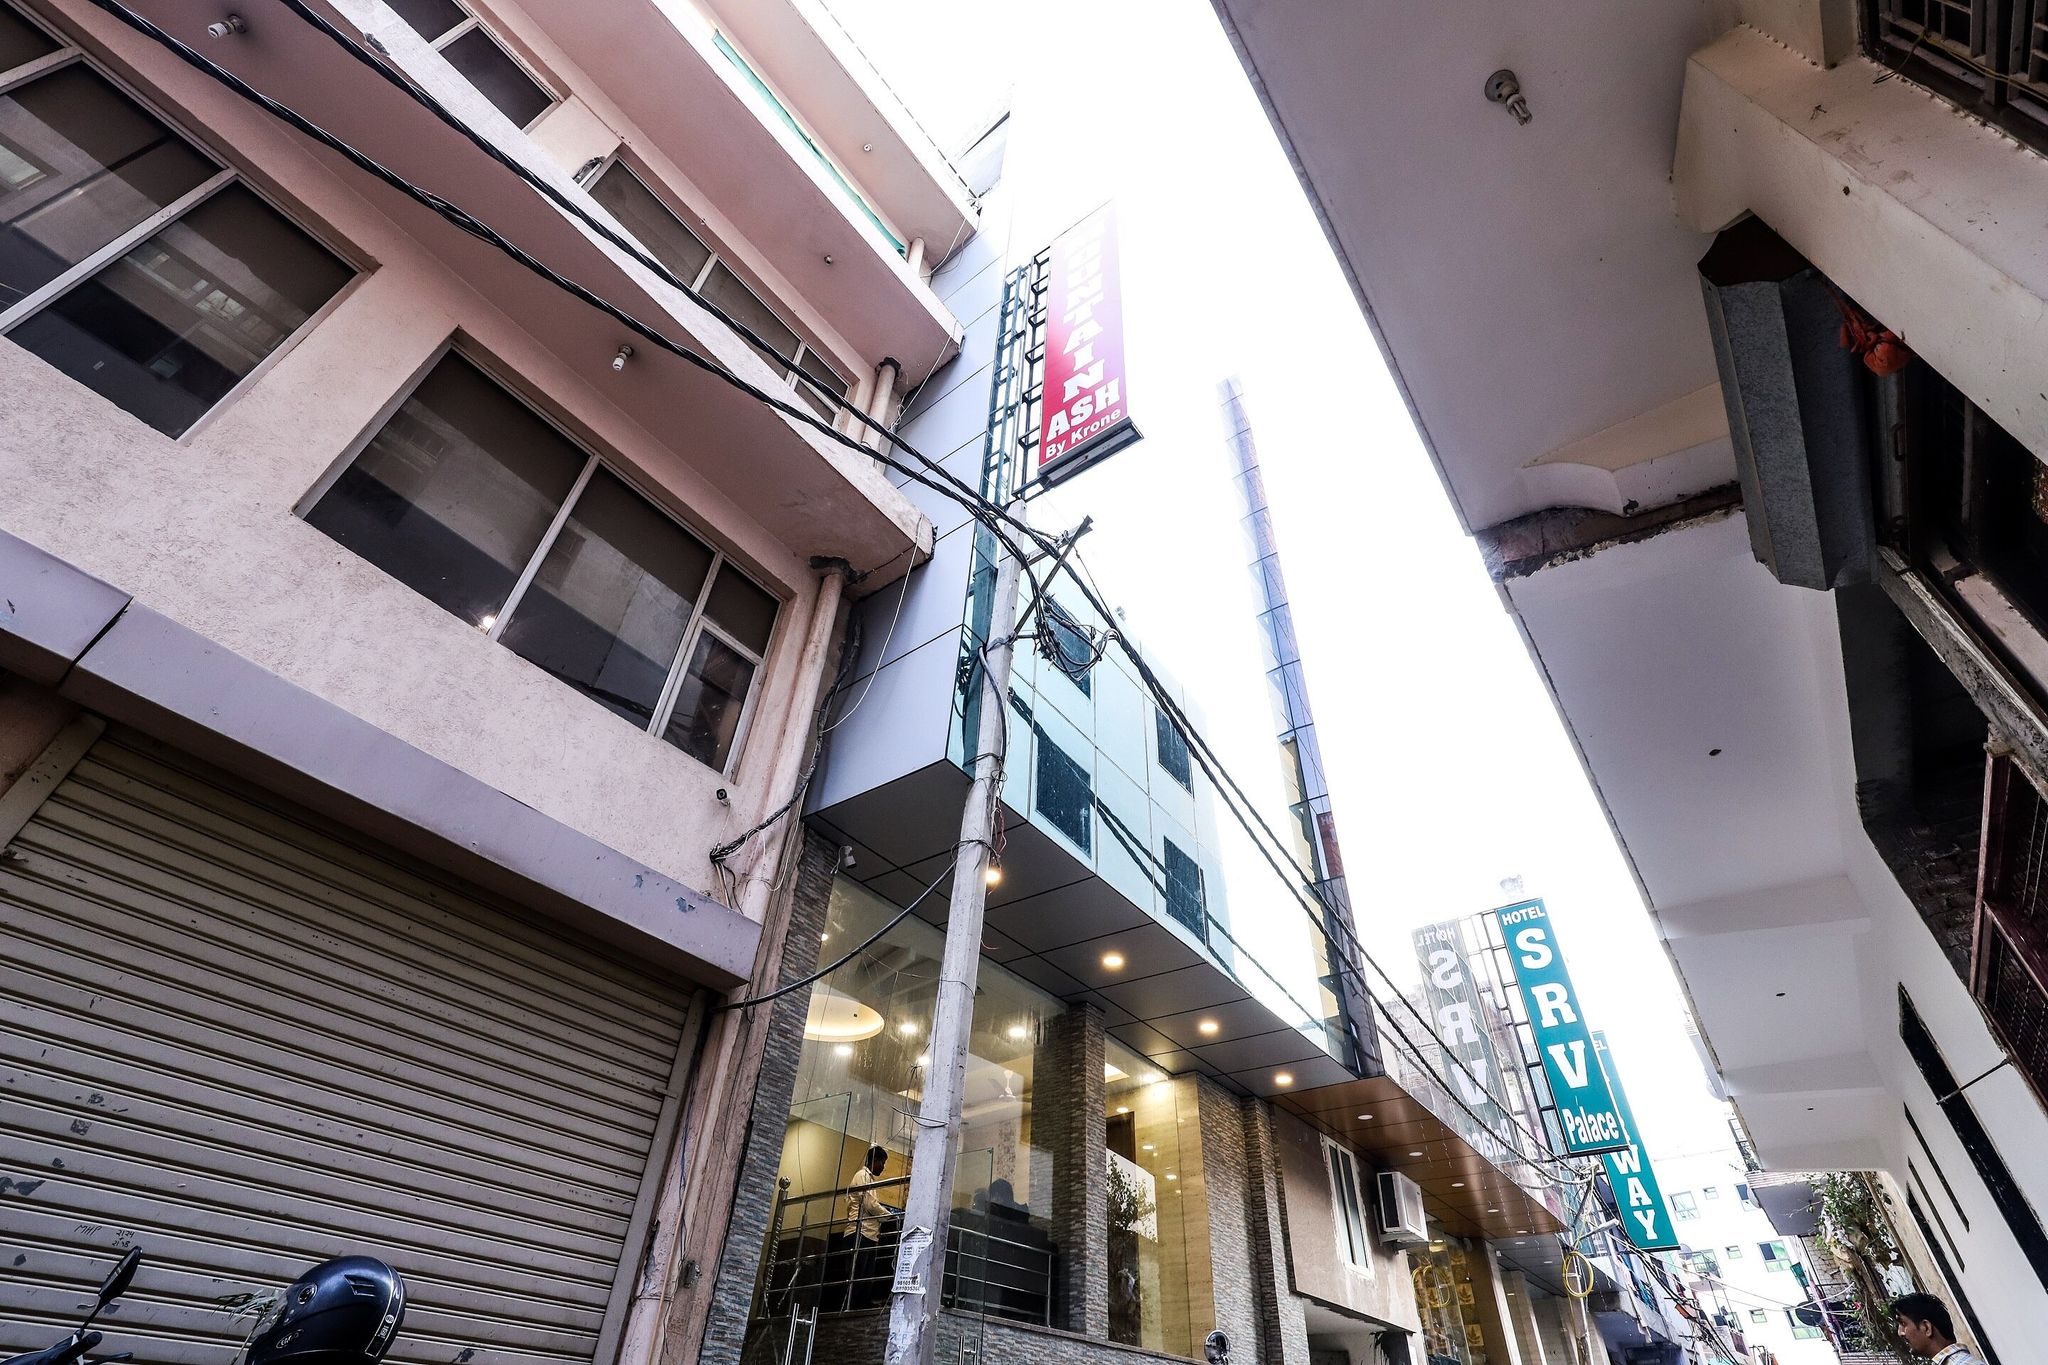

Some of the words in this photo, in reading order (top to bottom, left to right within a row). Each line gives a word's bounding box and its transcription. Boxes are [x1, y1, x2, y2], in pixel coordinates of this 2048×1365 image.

[1046, 376, 1120, 442] ASH
[1045, 439, 1066, 459] By
[1071, 408, 1122, 444] Krone
[1502, 905, 1546, 926] HOTEL
[1562, 1107, 1619, 1145] Palace
